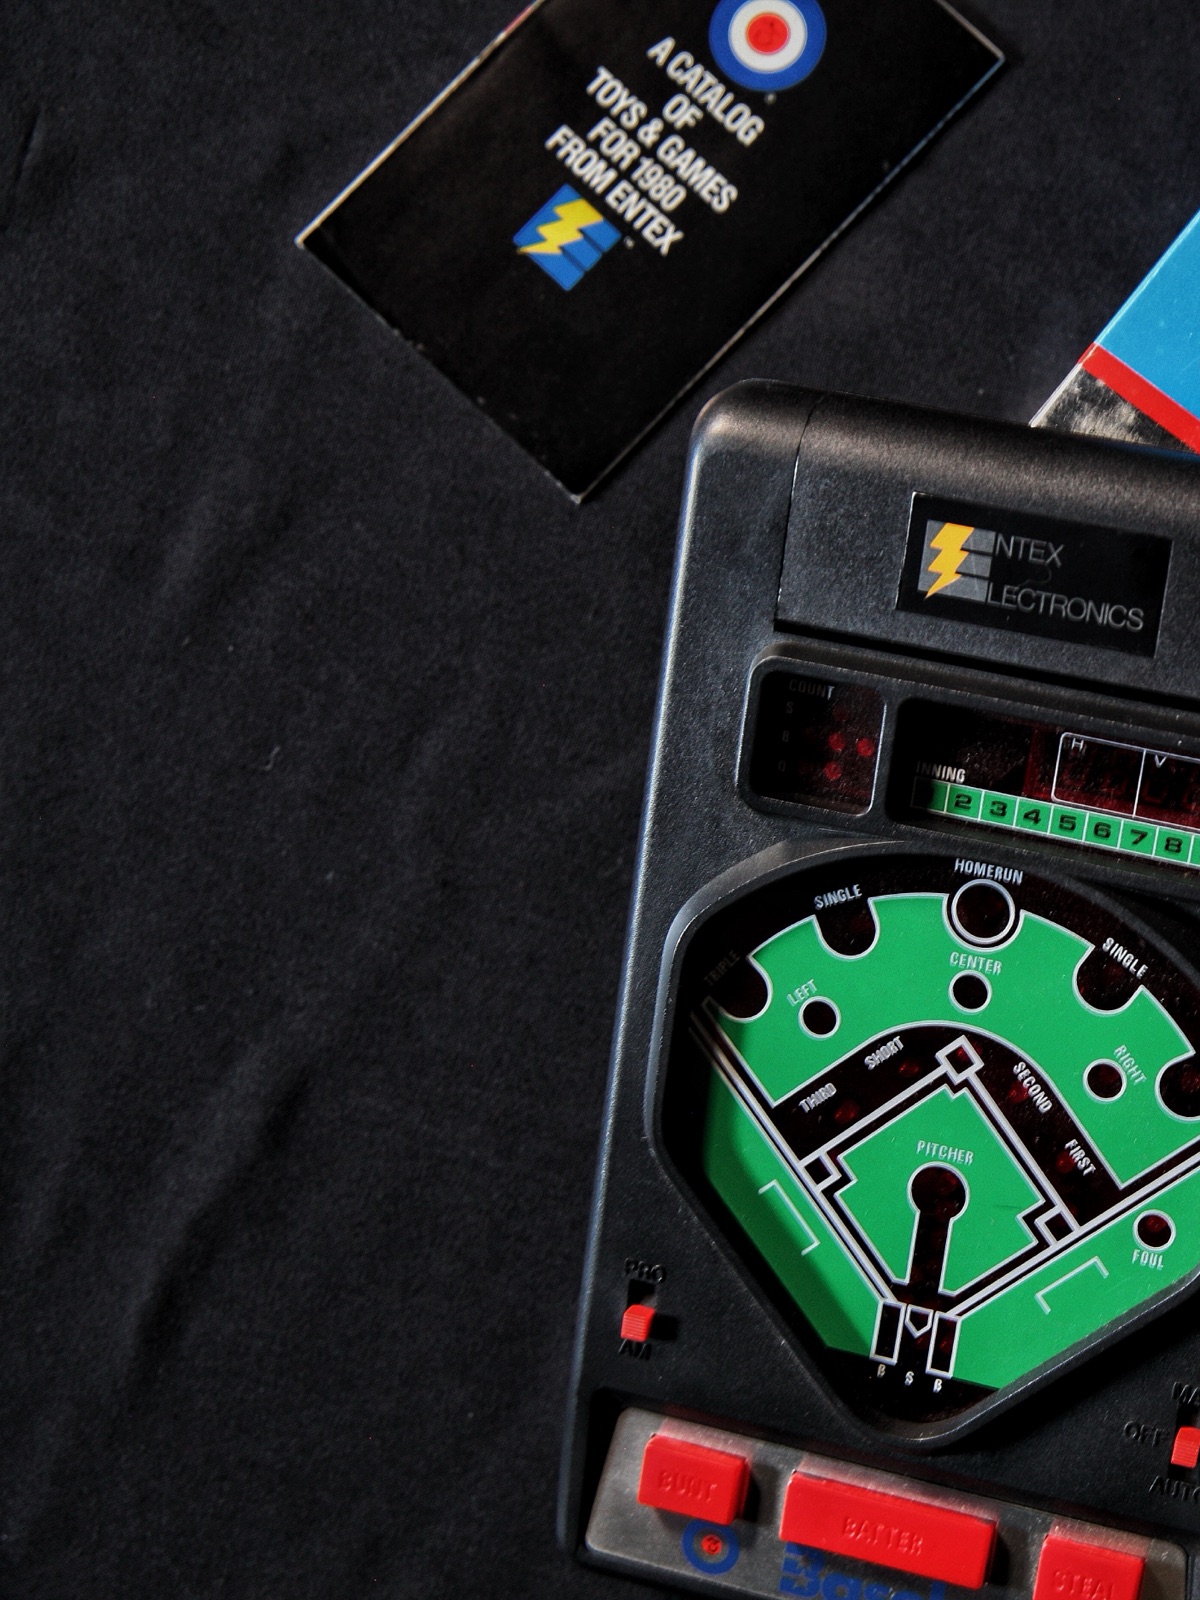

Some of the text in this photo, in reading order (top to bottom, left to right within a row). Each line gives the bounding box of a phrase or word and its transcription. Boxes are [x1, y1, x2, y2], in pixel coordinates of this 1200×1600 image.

[646, 36, 765, 147] A CATALOG
[662, 93, 704, 130] OF
[585, 65, 738, 214] TOYS & GAMES
[586, 116, 687, 213] FOR 1980
[544, 124, 685, 257] FROM ENTEX
[955, 794, 972, 809] 2
[990, 801, 1007, 818] 3
[1024, 808, 1041, 826] 4
[1059, 815, 1076, 832] 5
[1094, 822, 1111, 839] 6
[1130, 829, 1148, 845] 7
[1164, 837, 1182, 853] 8
[954, 858, 1023, 885] HOMERUN
[813, 884, 863, 911] SINGLE
[702, 949, 741, 987] TRIPLE
[949, 951, 1002, 975] CENTER
[1102, 937, 1149, 980] SINGLE
[787, 978, 819, 1007] LEFT
[863, 1036, 905, 1071] SHORT
[1113, 1044, 1148, 1086] RIGHT
[799, 1082, 837, 1114] THIRD
[1013, 1061, 1052, 1115] SECOND
[916, 1139, 974, 1167] PITCHER
[1064, 1138, 1096, 1177] FIRST
[625, 1257, 667, 1283] PRO
[1131, 1249, 1164, 1270] FOUL
[1122, 1420, 1169, 1447] OFF
[658, 1470, 717, 1503] BUNT
[842, 1517, 924, 1557] BATTER
